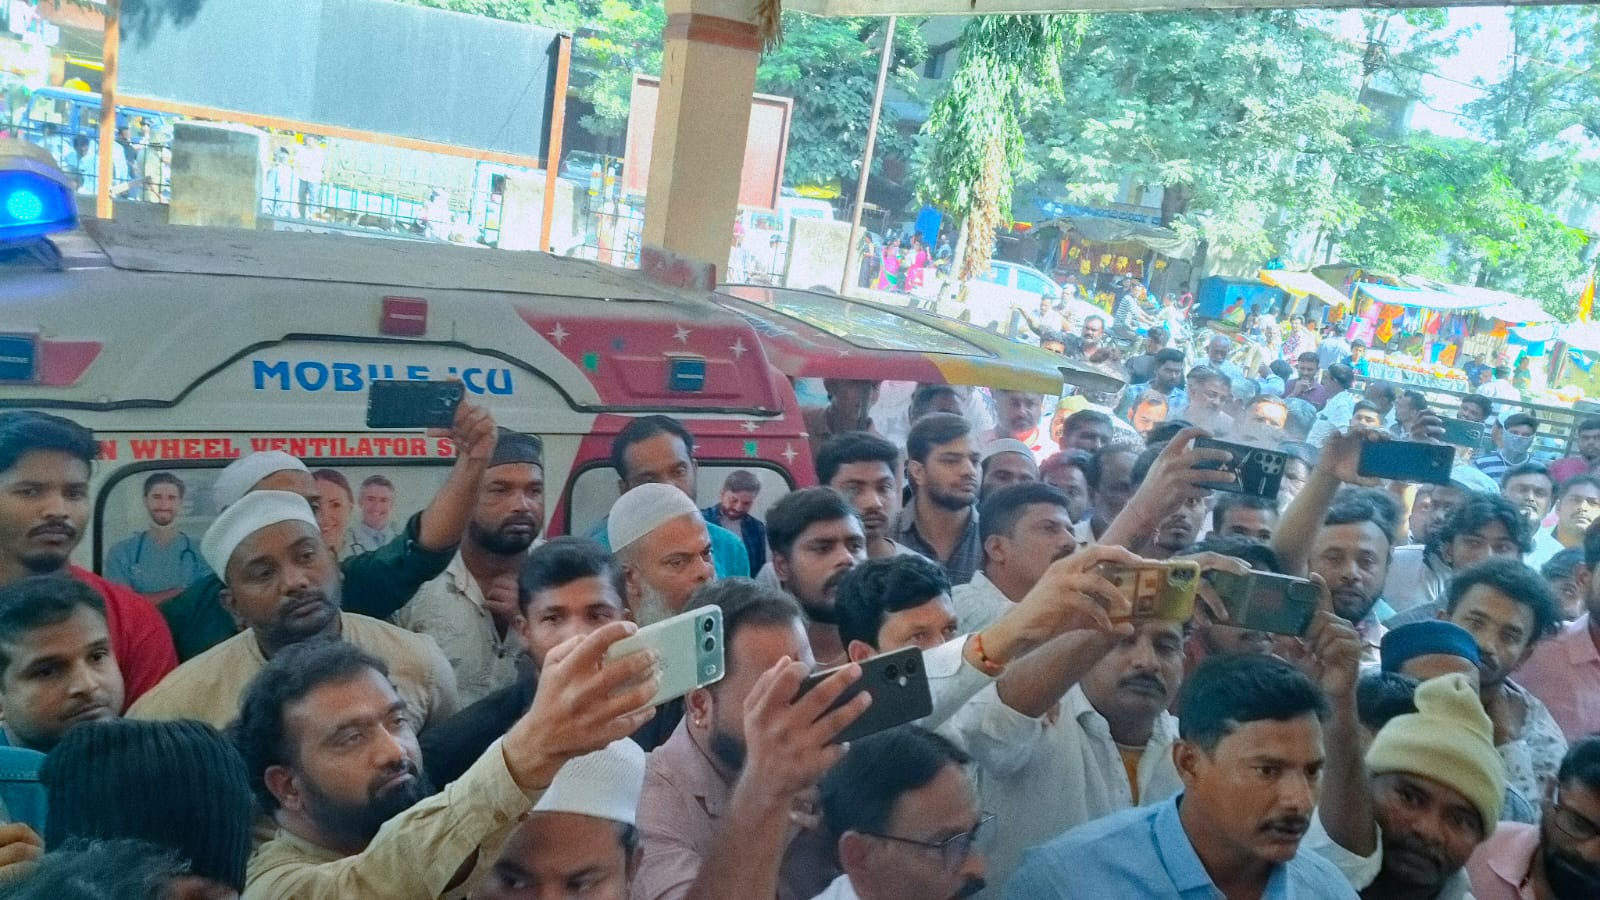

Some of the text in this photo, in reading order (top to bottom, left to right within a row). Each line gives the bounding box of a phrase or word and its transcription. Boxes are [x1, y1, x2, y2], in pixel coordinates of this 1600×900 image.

[447, 366, 514, 395] CU
[130, 438, 241, 459] WHEEL
[251, 437, 427, 457] VENTILATOR
